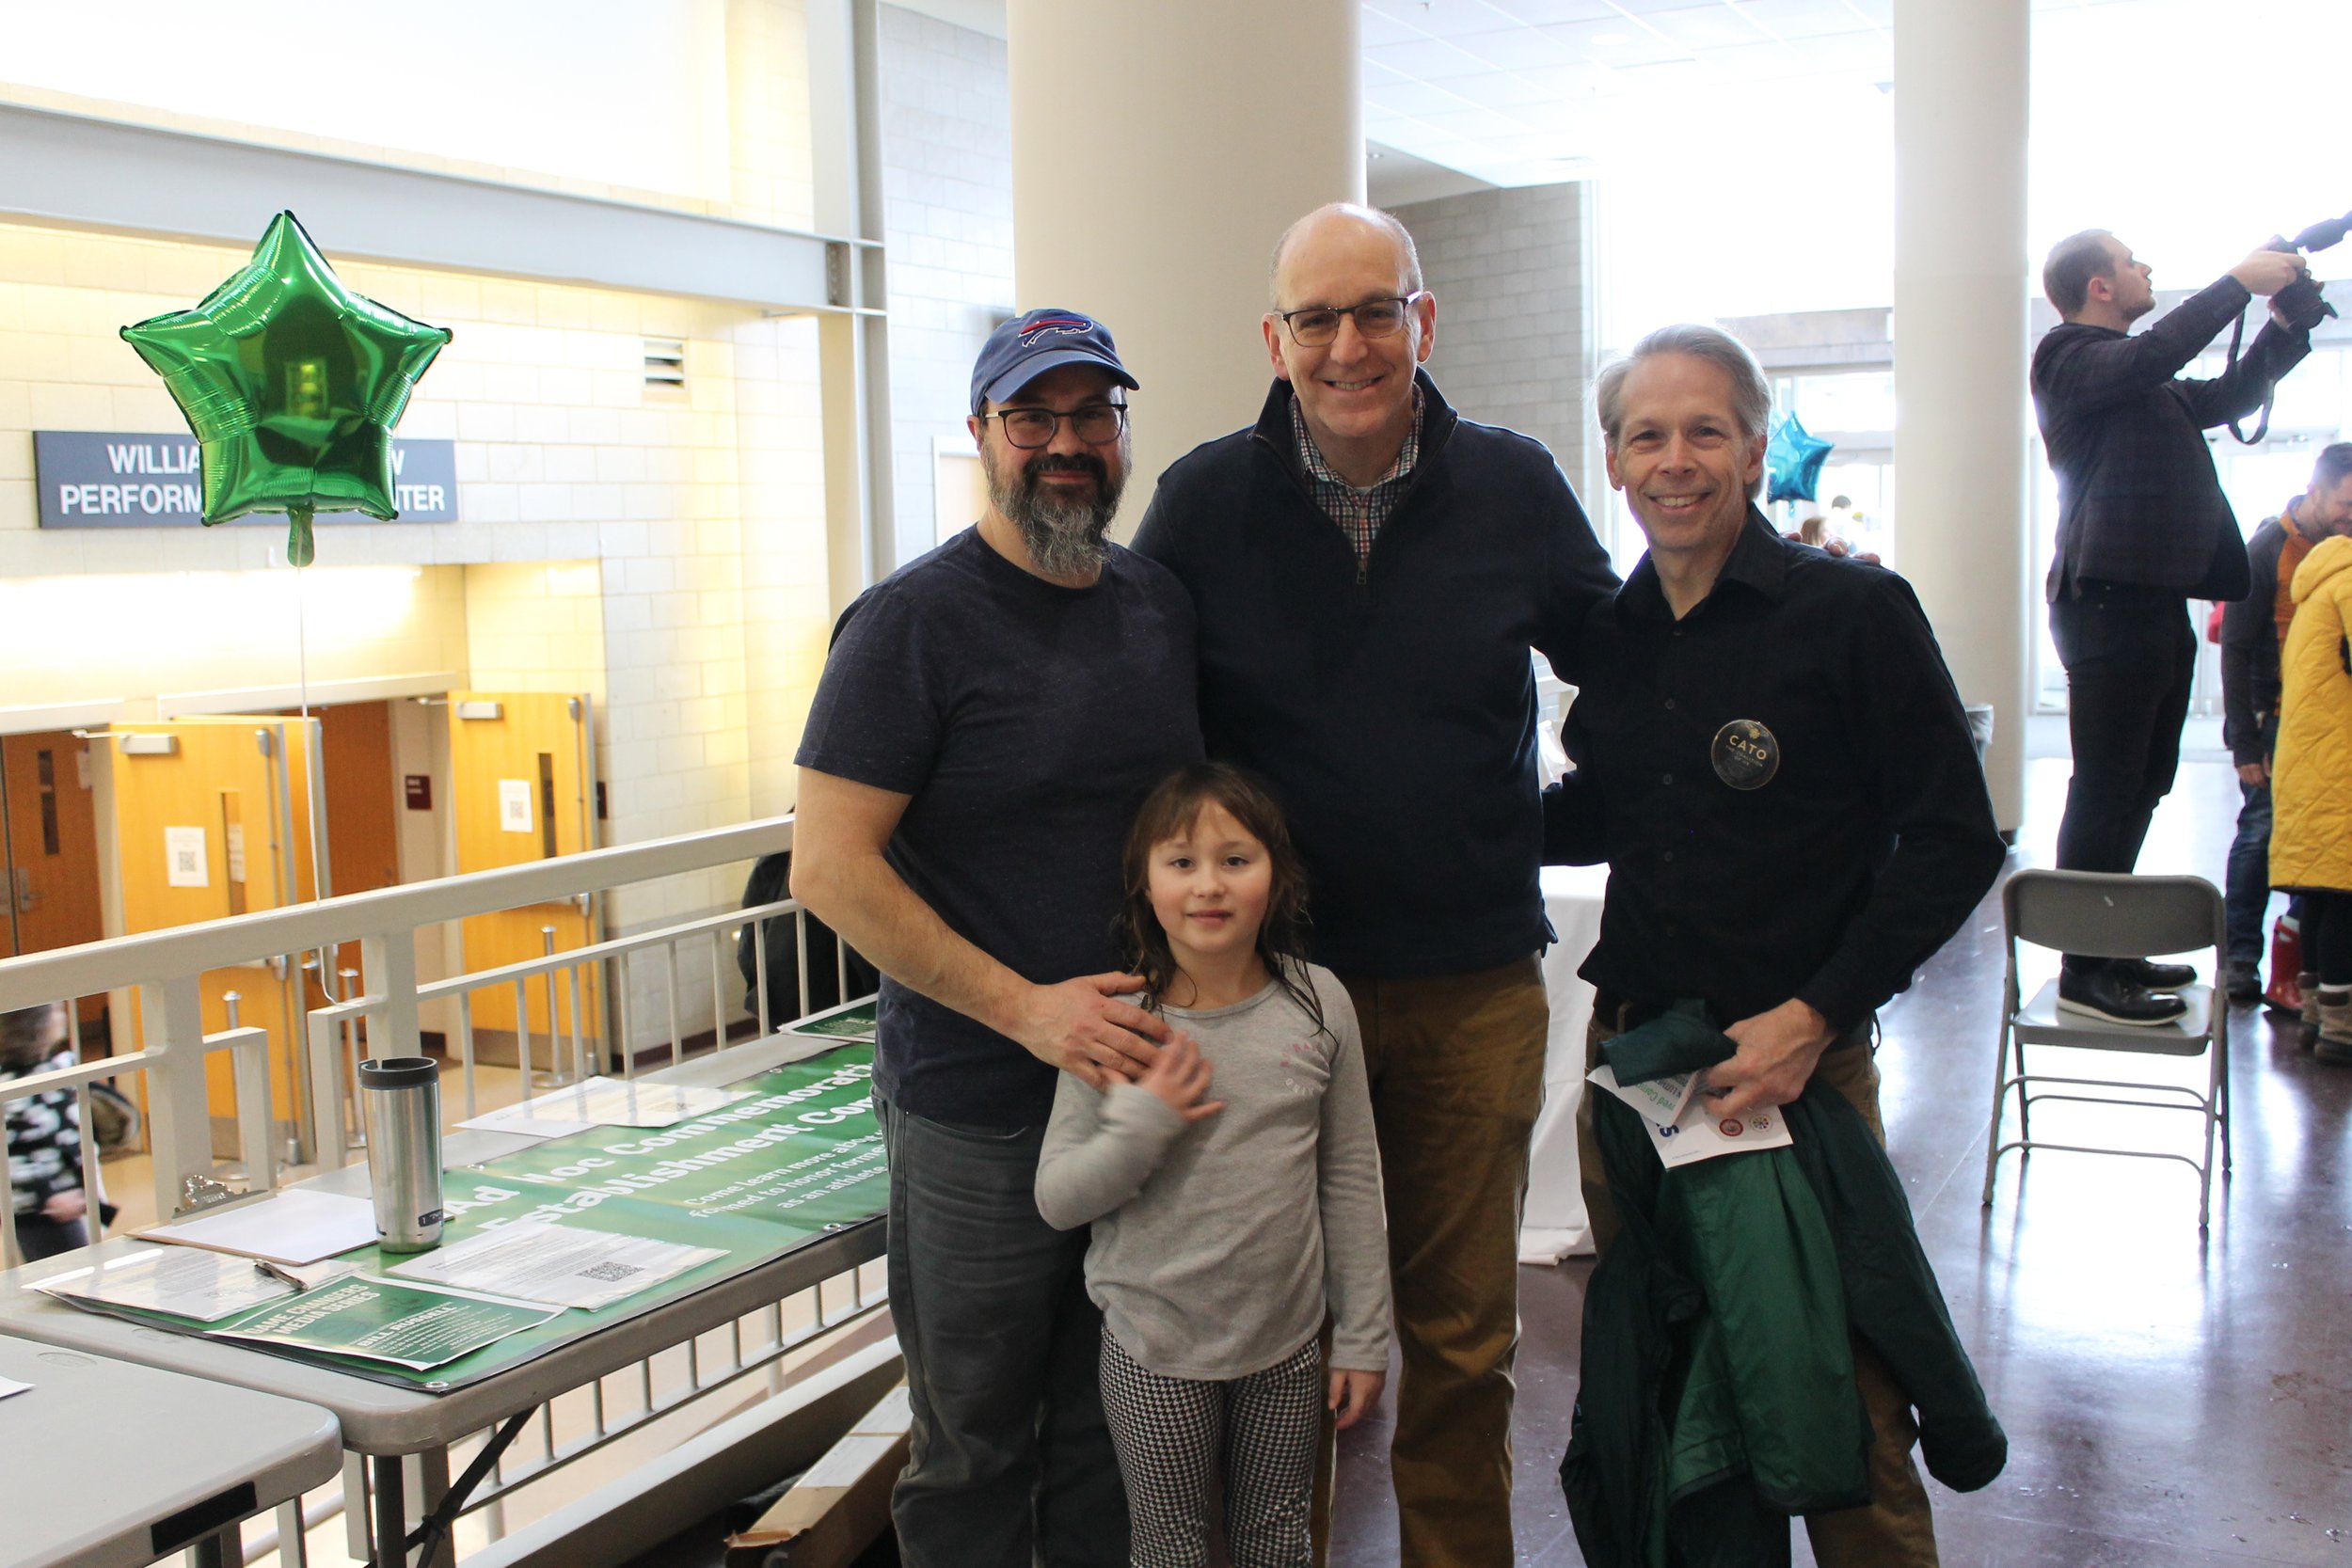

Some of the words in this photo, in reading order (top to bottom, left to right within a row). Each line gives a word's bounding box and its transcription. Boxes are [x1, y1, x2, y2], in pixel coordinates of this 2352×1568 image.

[106, 444, 200, 474] WILLIA
[59, 483, 202, 515] PERFORM
[395, 483, 446, 512] TER
[1729, 735, 1767, 760] CATO
[603, 1063, 873, 1156] Commemorati
[684, 1185, 744, 1206] Come
[734, 1167, 793, 1186] learn
[787, 1152, 836, 1170] more
[689, 1195, 767, 1218] formed
[757, 1187, 787, 1196] to
[777, 1167, 838, 1188] honor
[829, 1144, 886, 1169] forme
[777, 1198, 805, 1209] as
[801, 1189, 831, 1199] an
[243, 1313, 294, 1335] GAME
[286, 1284, 370, 1315] CHANGERS
[273, 1309, 331, 1335] MEDIA
[324, 1291, 381, 1312] SERIES
[357, 1331, 395, 1347] BILL
[389, 1307, 457, 1330] RUSSELL
